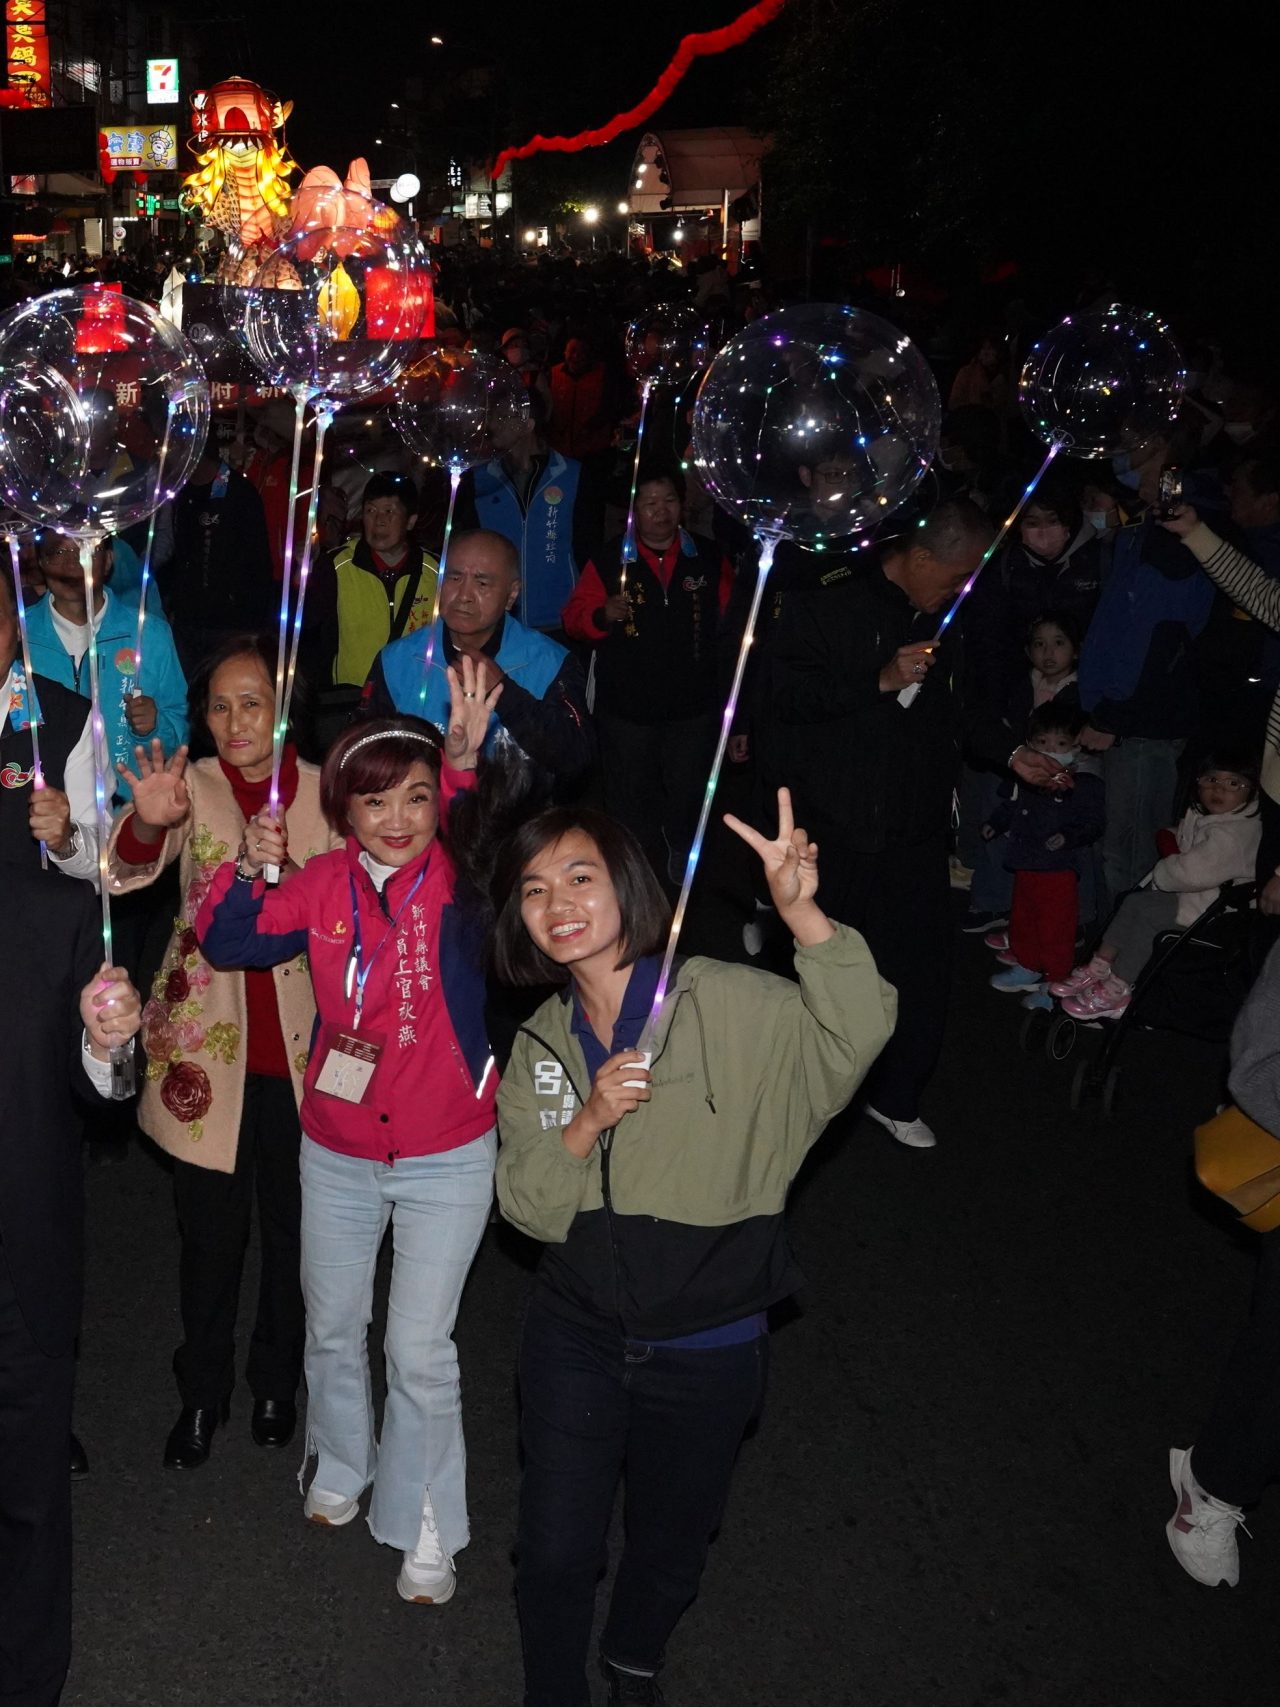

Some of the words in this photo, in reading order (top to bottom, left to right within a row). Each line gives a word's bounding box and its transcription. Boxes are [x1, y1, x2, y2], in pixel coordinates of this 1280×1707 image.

[116, 382, 138, 405] 新
[411, 903, 433, 991] 新竹縣議會
